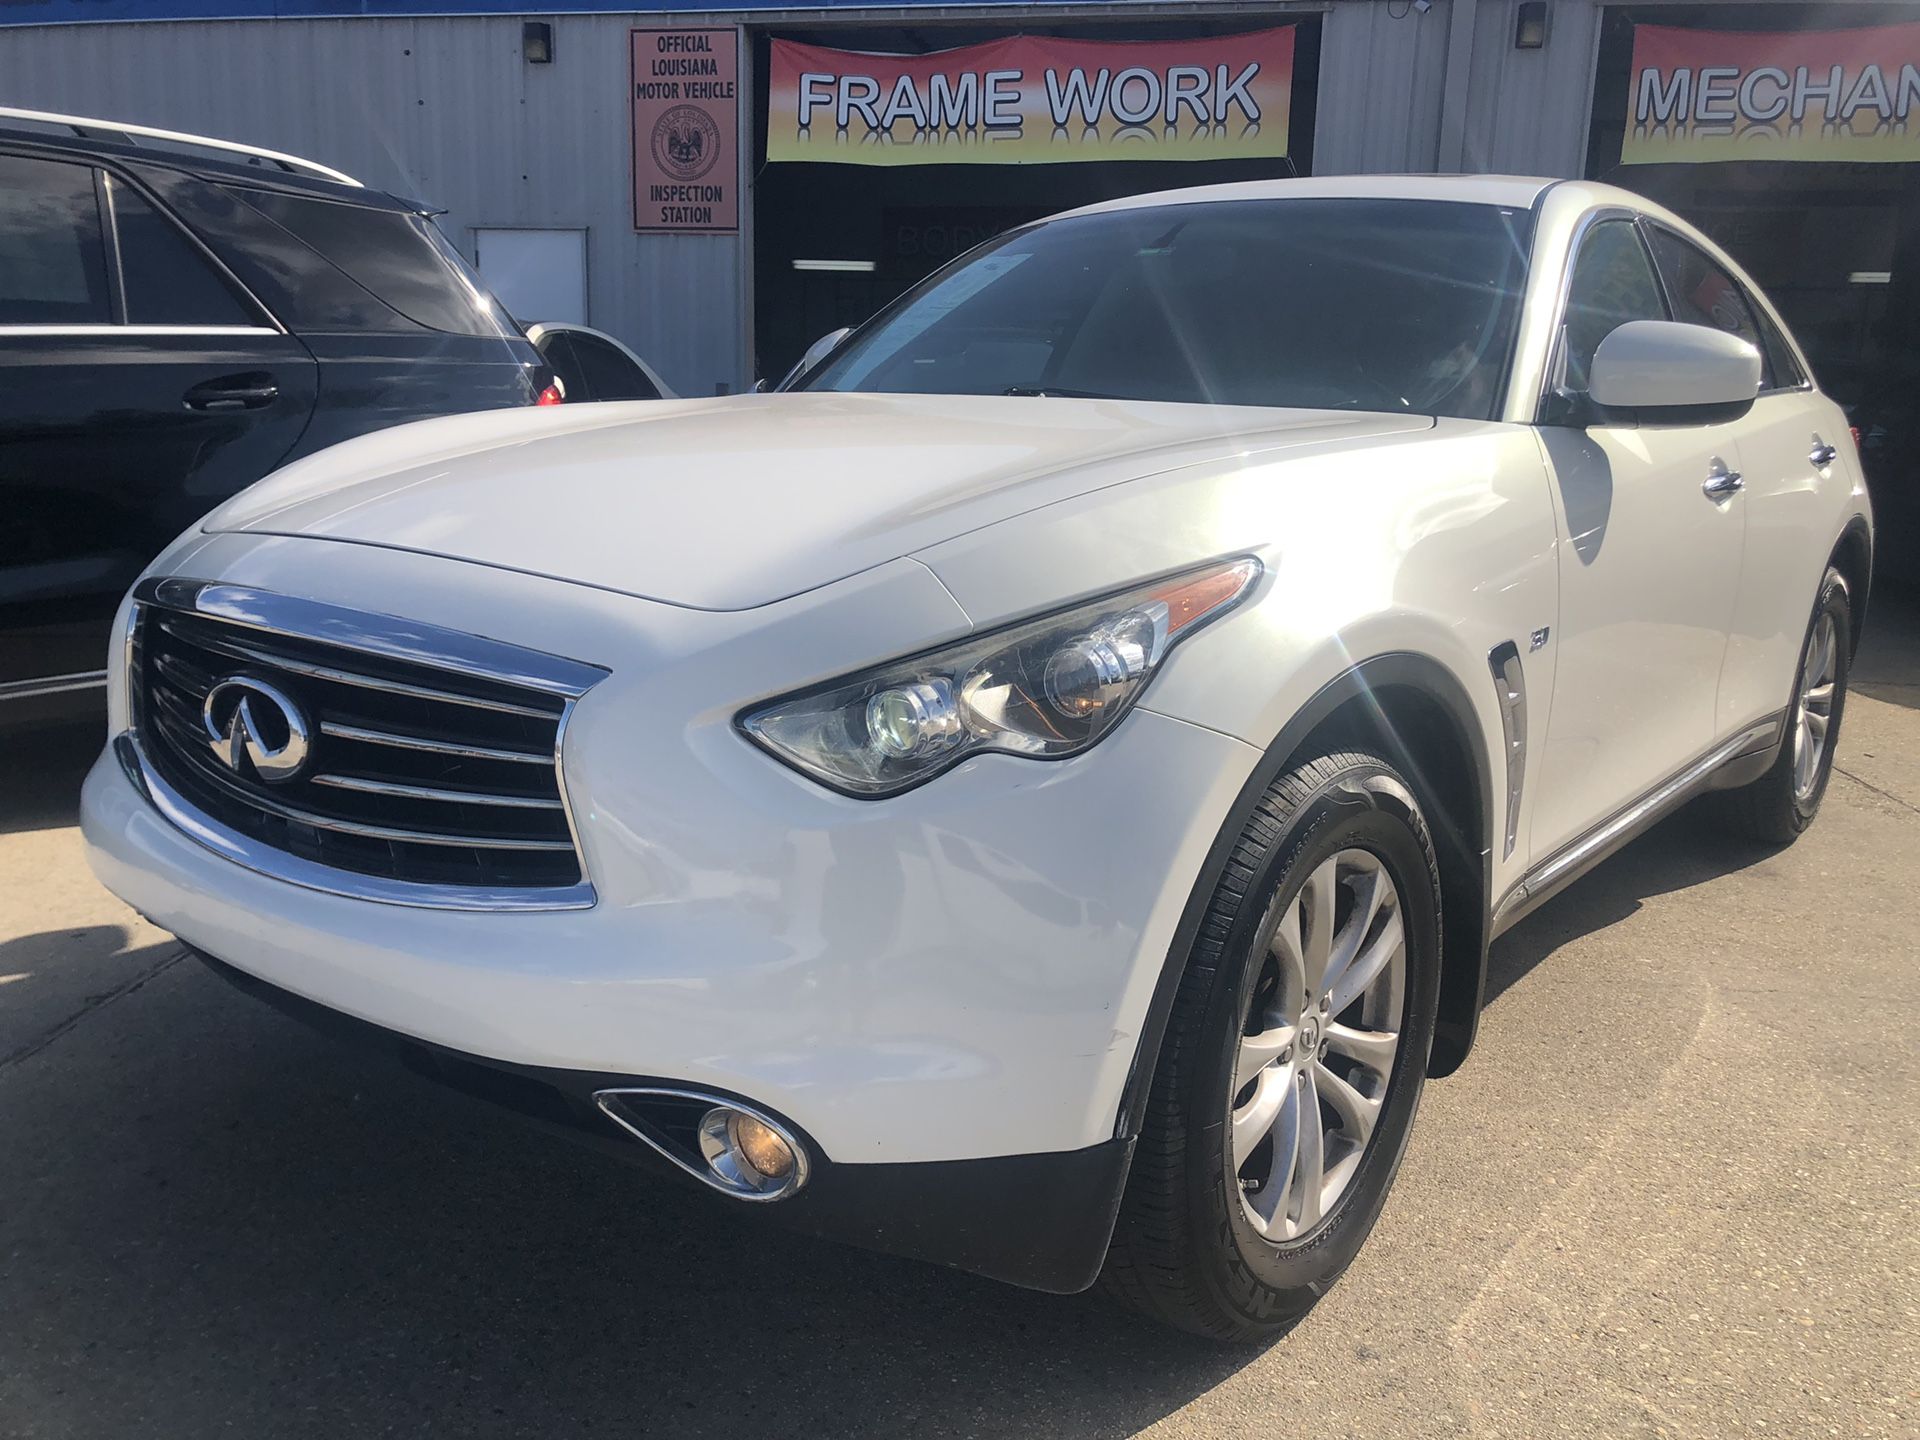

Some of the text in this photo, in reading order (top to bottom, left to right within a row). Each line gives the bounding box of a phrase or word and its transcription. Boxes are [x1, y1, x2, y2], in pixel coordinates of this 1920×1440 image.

[657, 35, 712, 52] OFFICIAL
[652, 58, 718, 76] LOUISIANA
[636, 81, 734, 99] MOTOR VEHICLE
[797, 61, 1262, 130] FRAME WORK
[650, 185, 722, 202] INSPECTION
[661, 207, 712, 224] STATION
